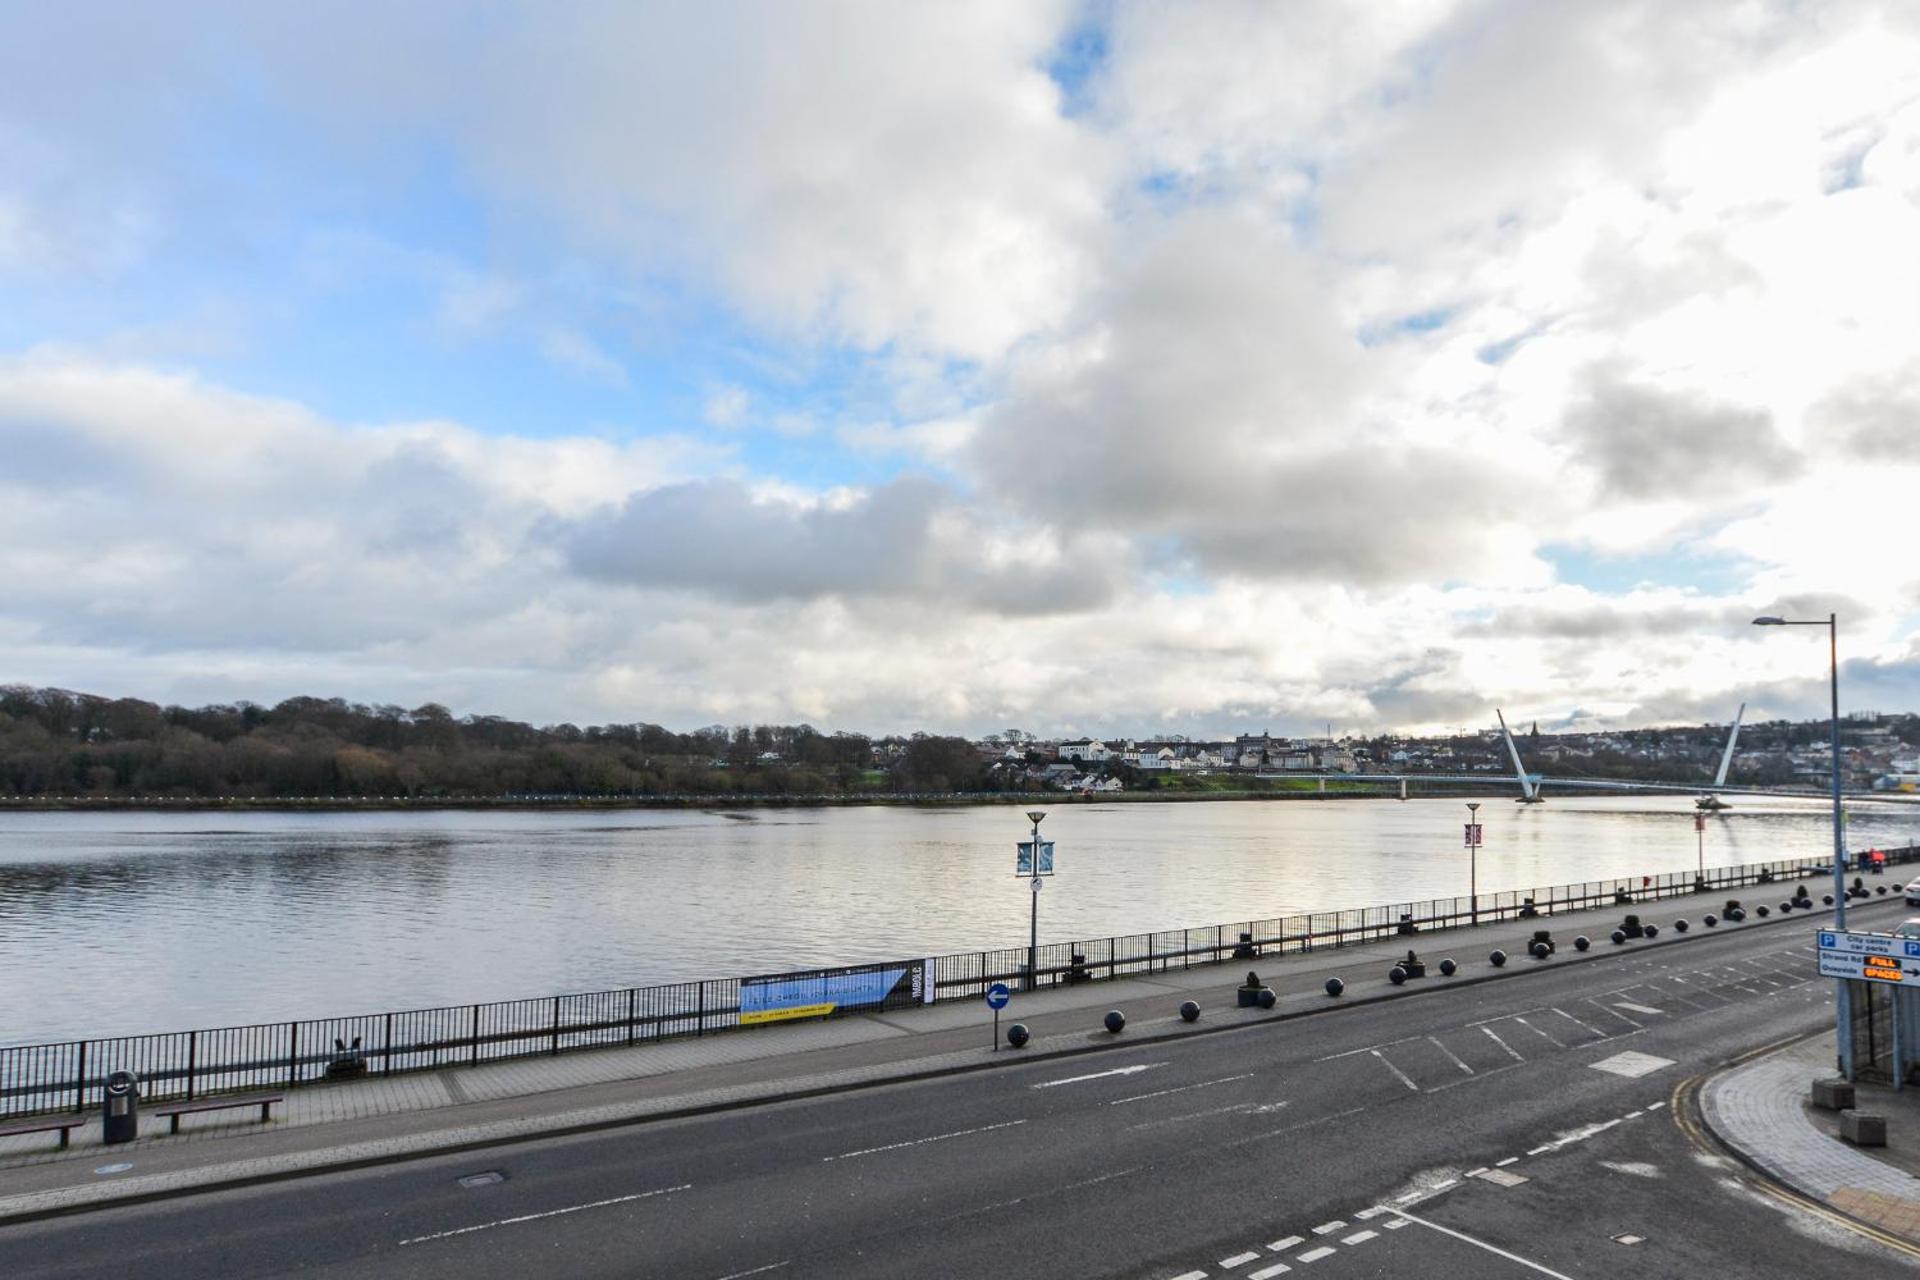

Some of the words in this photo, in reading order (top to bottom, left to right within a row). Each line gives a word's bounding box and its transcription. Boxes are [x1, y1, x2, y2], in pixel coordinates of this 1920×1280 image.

[1846, 935, 1864, 944] City
[1865, 938, 1892, 946] centre
[1866, 945, 1889, 953] parks
[1822, 952, 1849, 962] Strand
[1870, 956, 1896, 967] FULL
[1865, 968, 1903, 980] SPACES
